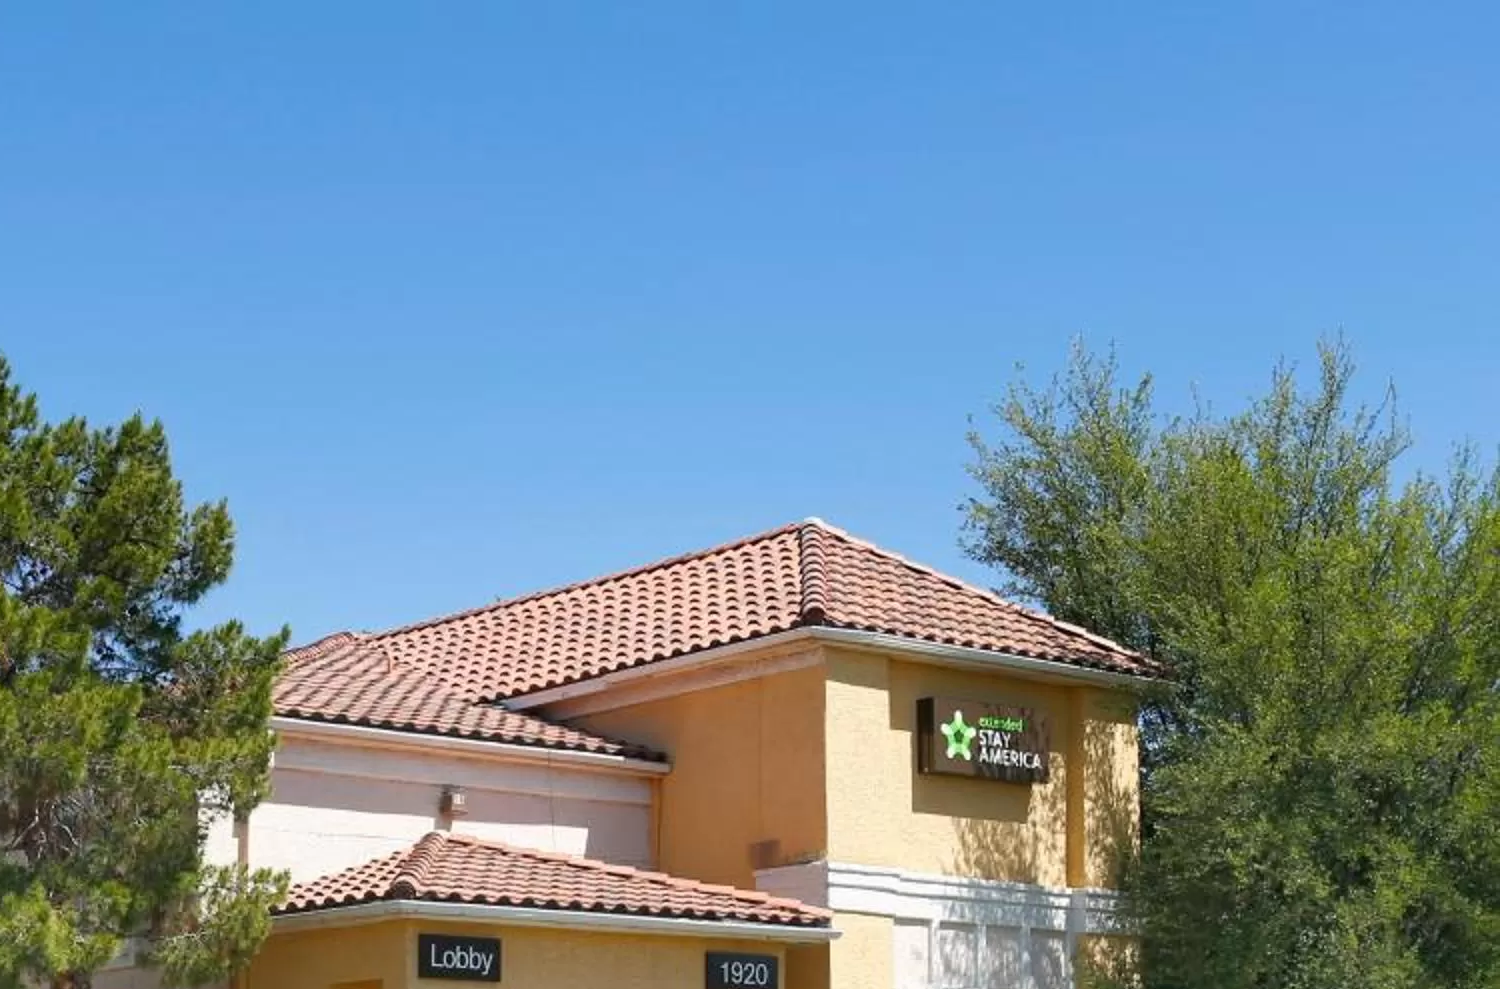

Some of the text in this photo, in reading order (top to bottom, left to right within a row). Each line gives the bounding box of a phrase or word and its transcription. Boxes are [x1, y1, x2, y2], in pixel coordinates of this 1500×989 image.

[979, 729, 1011, 748] STAY
[979, 748, 1043, 769] AMERICA
[431, 943, 493, 975] Lobby
[720, 961, 768, 985] 1920
